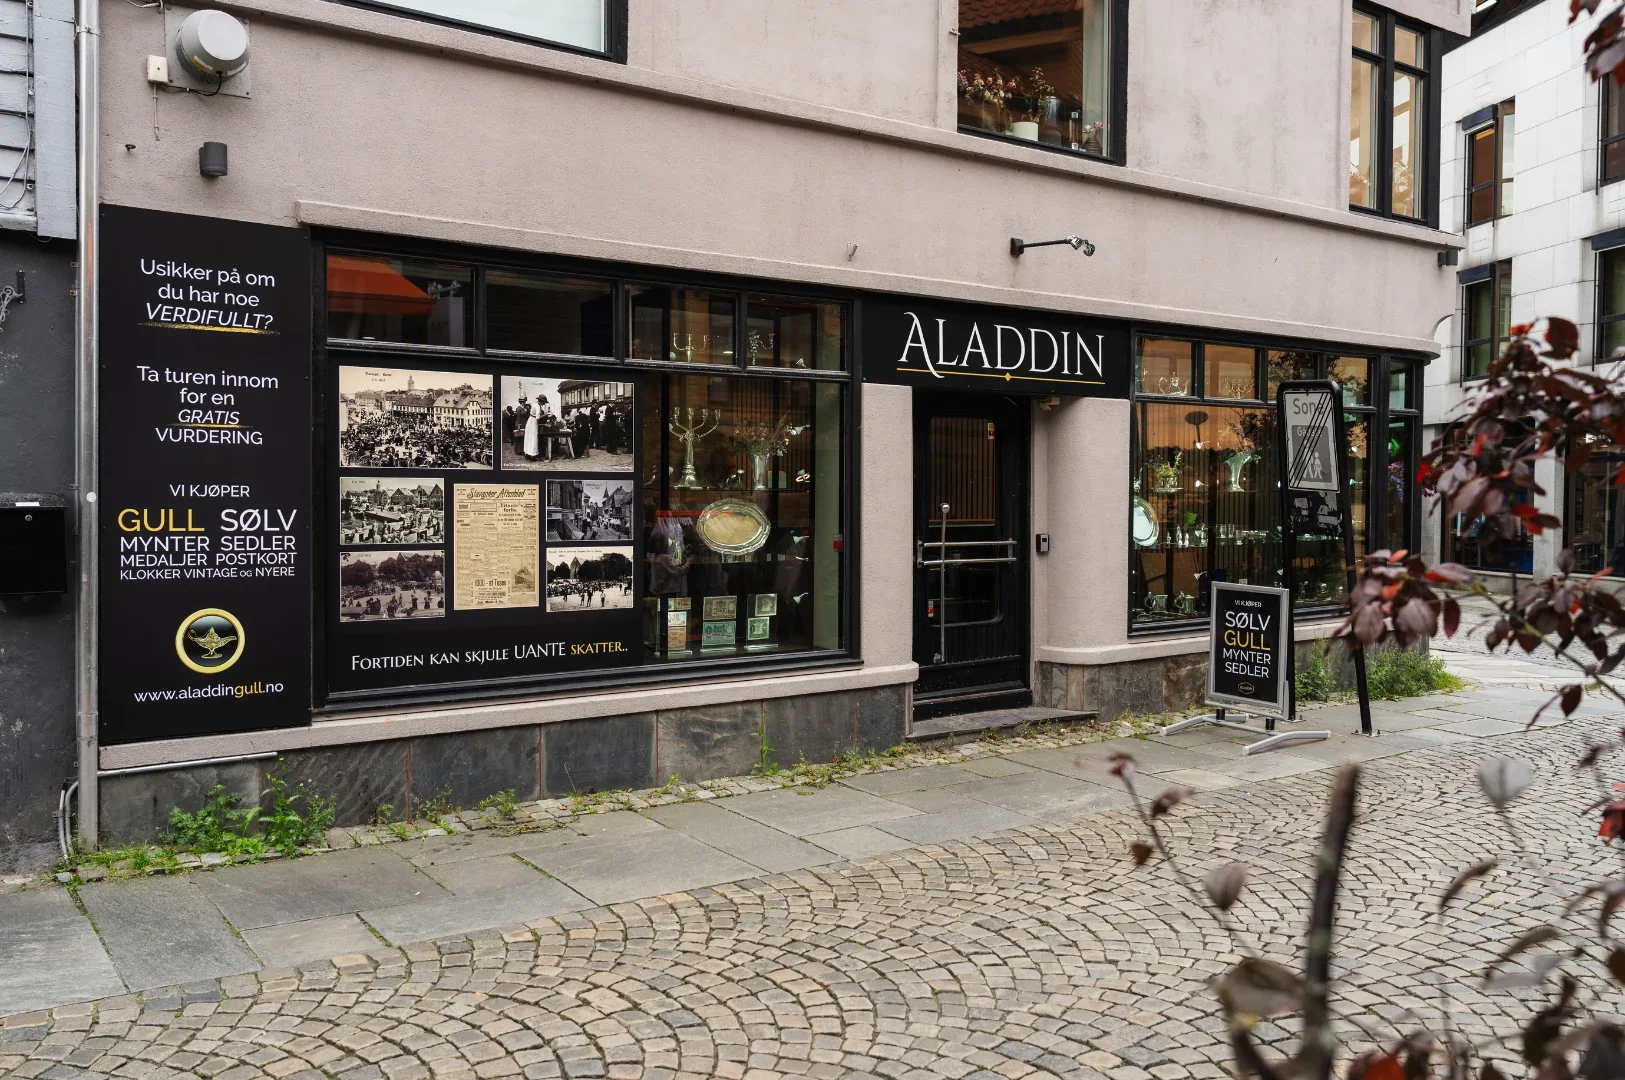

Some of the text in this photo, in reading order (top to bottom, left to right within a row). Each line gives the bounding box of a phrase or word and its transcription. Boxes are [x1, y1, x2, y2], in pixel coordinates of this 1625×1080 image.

[140, 259, 275, 287] Usikker på om
[158, 284, 259, 306] du har noe
[146, 303, 273, 328] VERDIFULLT?
[898, 312, 1104, 378] ALADDIN
[136, 366, 278, 388] Ta turen innom
[180, 388, 234, 405] for en
[1293, 398, 1323, 414] Sone
[178, 409, 239, 424] GRATIS
[156, 428, 262, 444] VURDERING
[170, 484, 250, 497] VI KJØPER
[117, 508, 297, 532] GULL SØLV
[121, 536, 295, 552] MYNTER SEDLER
[121, 552, 297, 566] MEDALJER POSTKORT
[121, 569, 180, 580] KLOKKER
[184, 568, 237, 578] VINTAGE
[256, 567, 295, 576] NYERE
[1241, 600, 1262, 608] KJØPER
[1225, 611, 1270, 630] SØLV
[1224, 630, 1270, 650] GULL
[515, 642, 565, 658] UANTE
[1223, 648, 1271, 664] MYNTER
[1225, 662, 1269, 678] SEDLER
[134, 682, 283, 702] www.aladdingull.no
